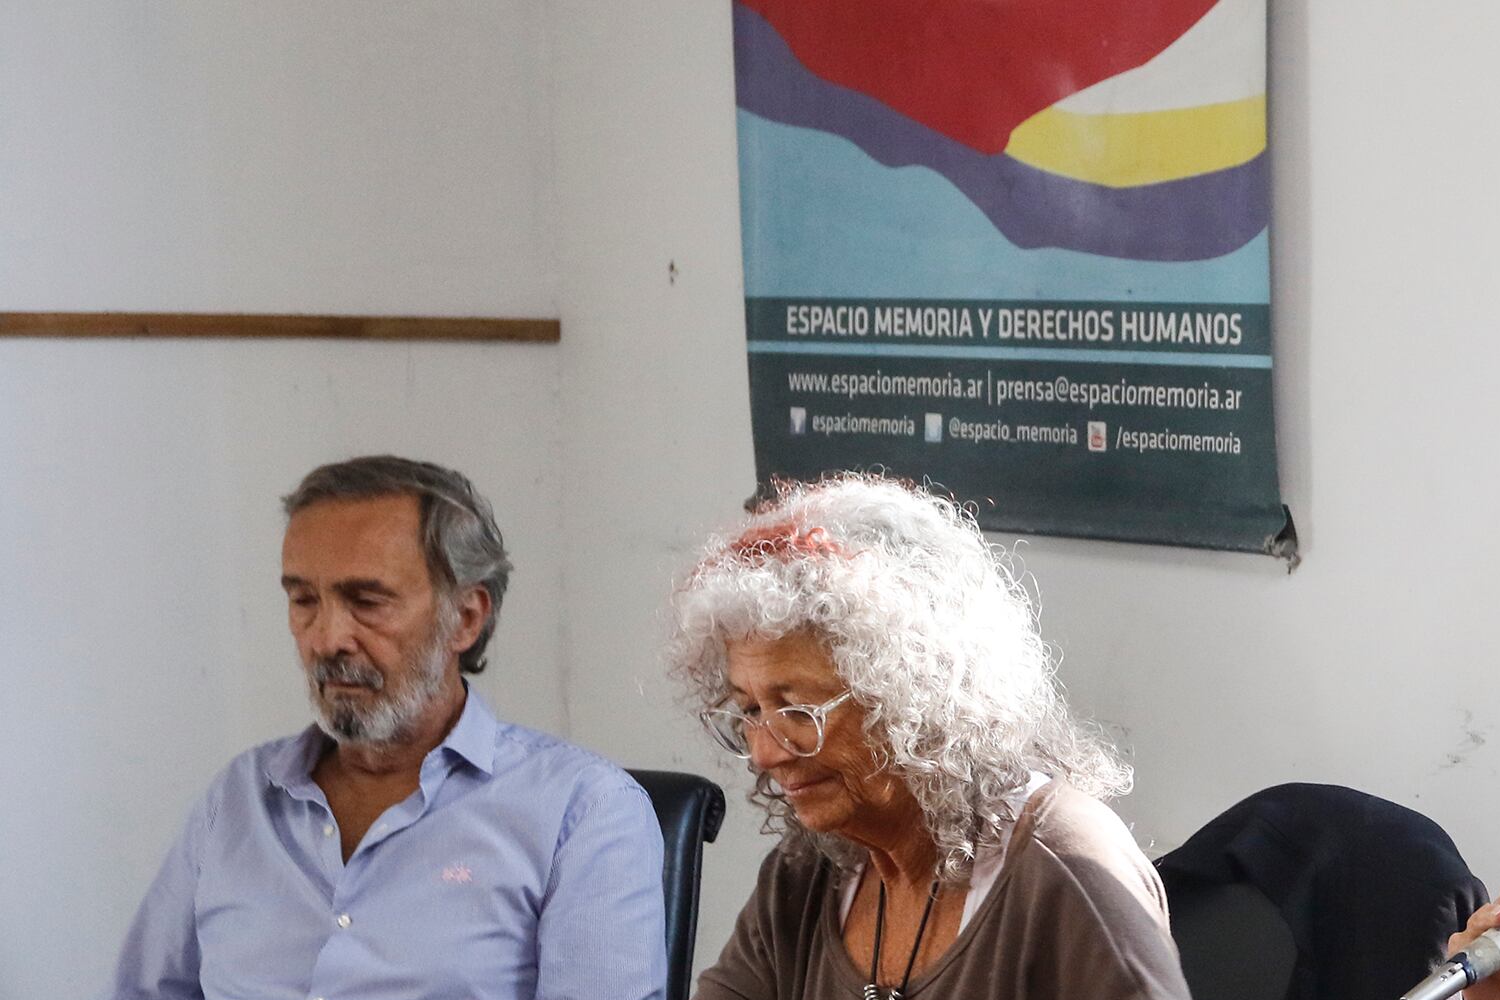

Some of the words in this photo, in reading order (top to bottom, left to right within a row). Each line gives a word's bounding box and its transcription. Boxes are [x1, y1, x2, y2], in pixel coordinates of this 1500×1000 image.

[787, 306, 869, 336] ESPACIO
[874, 307, 974, 339] MEMORIA
[979, 308, 993, 338] Y
[998, 309, 1114, 341] DERECHOS
[1121, 312, 1243, 345] HUMANOS
[788, 370, 983, 398] www.espaciomemoria.ar
[997, 376, 1243, 409] prensa@espaciomemoria.ar
[812, 413, 916, 437] espaciomemoria
[949, 416, 1078, 444] @espacio_memoria
[1115, 427, 1242, 454] /espaciomemoria
